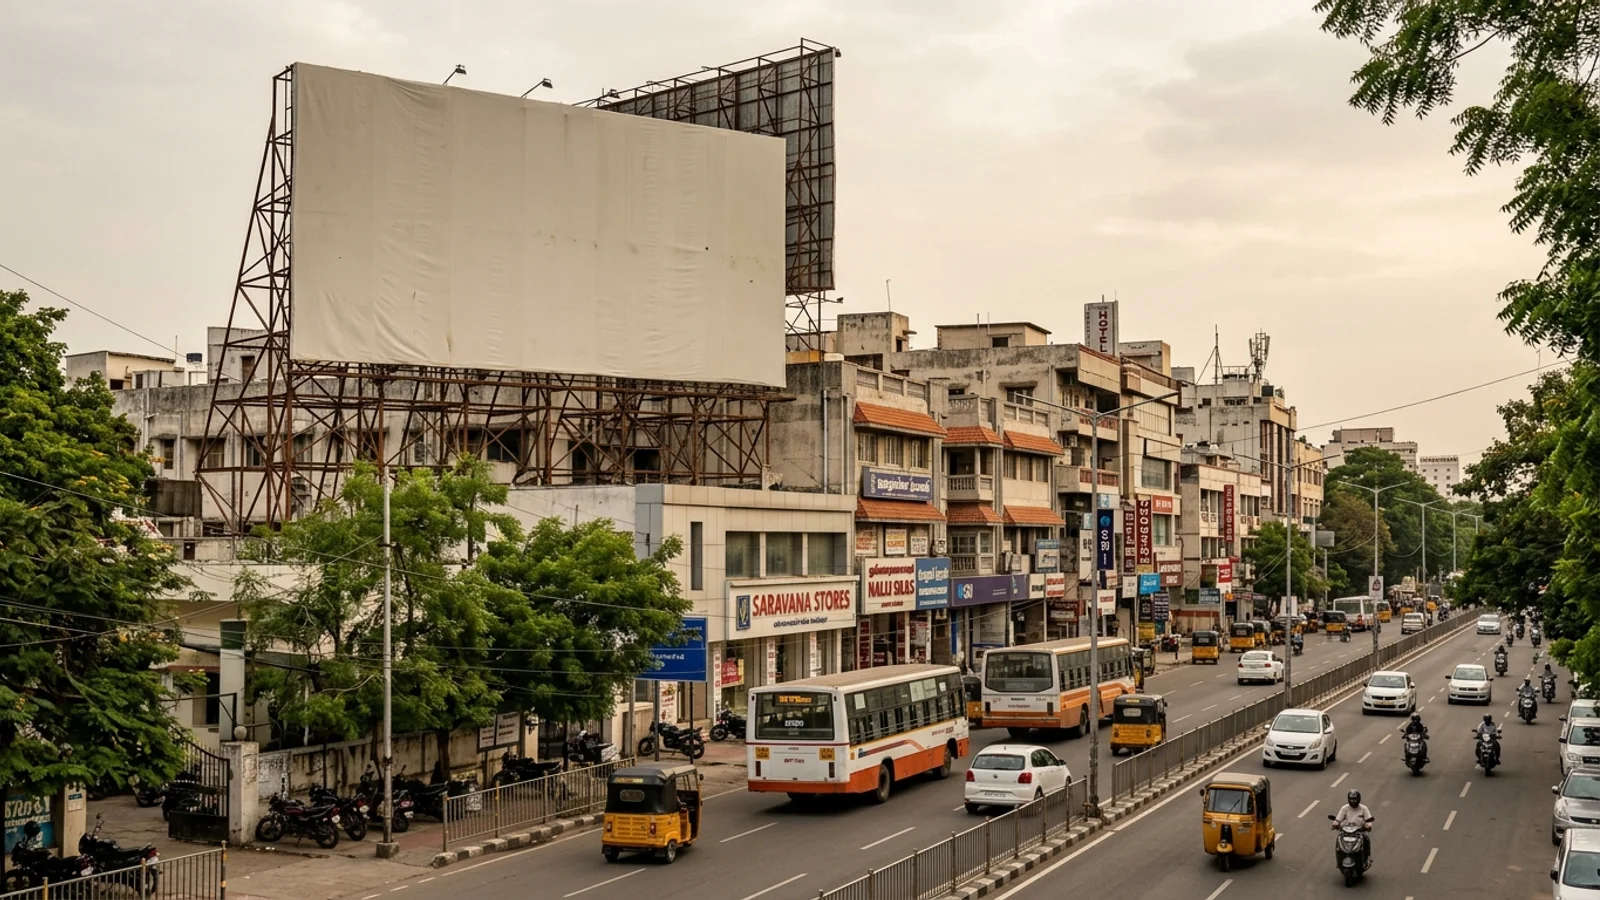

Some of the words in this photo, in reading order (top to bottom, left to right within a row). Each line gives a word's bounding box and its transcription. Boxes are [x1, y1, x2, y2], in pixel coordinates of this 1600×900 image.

[1099, 310, 1108, 353] HOTEL
[752, 592, 812, 617] SARAVANA
[814, 589, 850, 612] STORES
